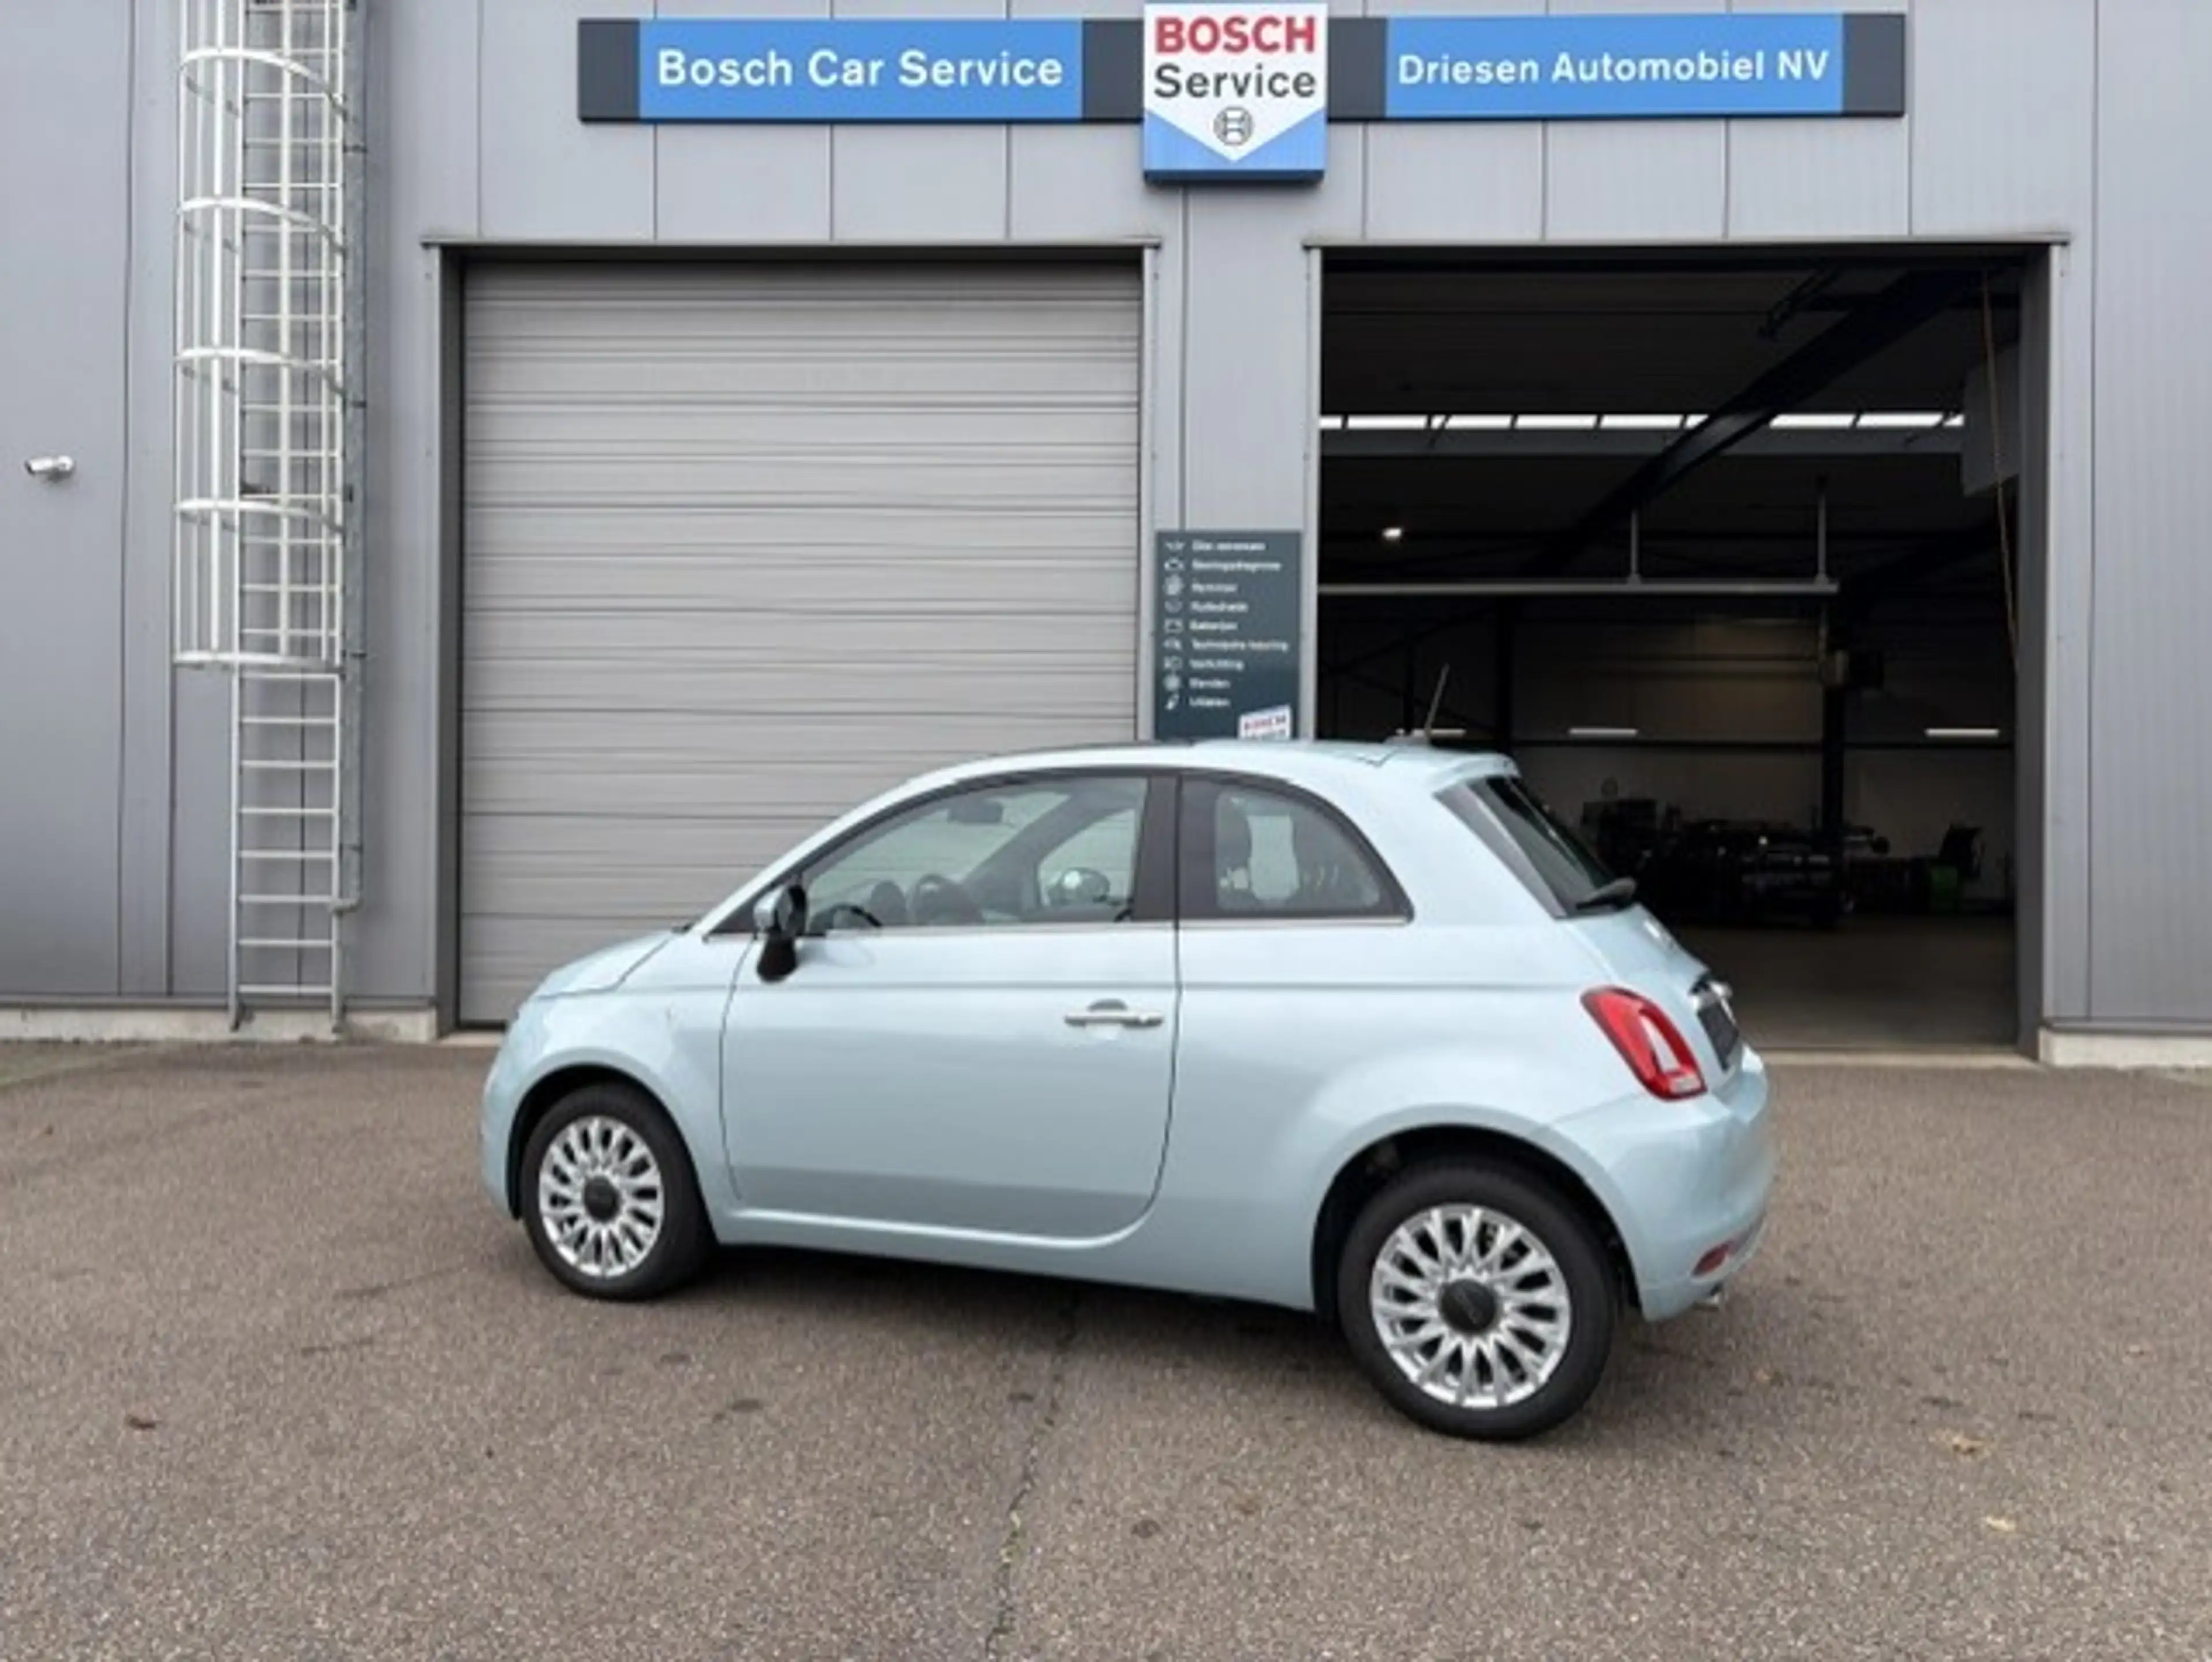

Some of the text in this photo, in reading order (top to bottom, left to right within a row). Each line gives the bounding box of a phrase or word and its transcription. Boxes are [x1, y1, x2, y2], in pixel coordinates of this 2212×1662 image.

[1155, 16, 1316, 53] BOSCH
[659, 50, 1062, 87] Bosch Car Service
[1154, 63, 1316, 98] Service
[1399, 50, 1829, 84] Driesen Automobiel NV
